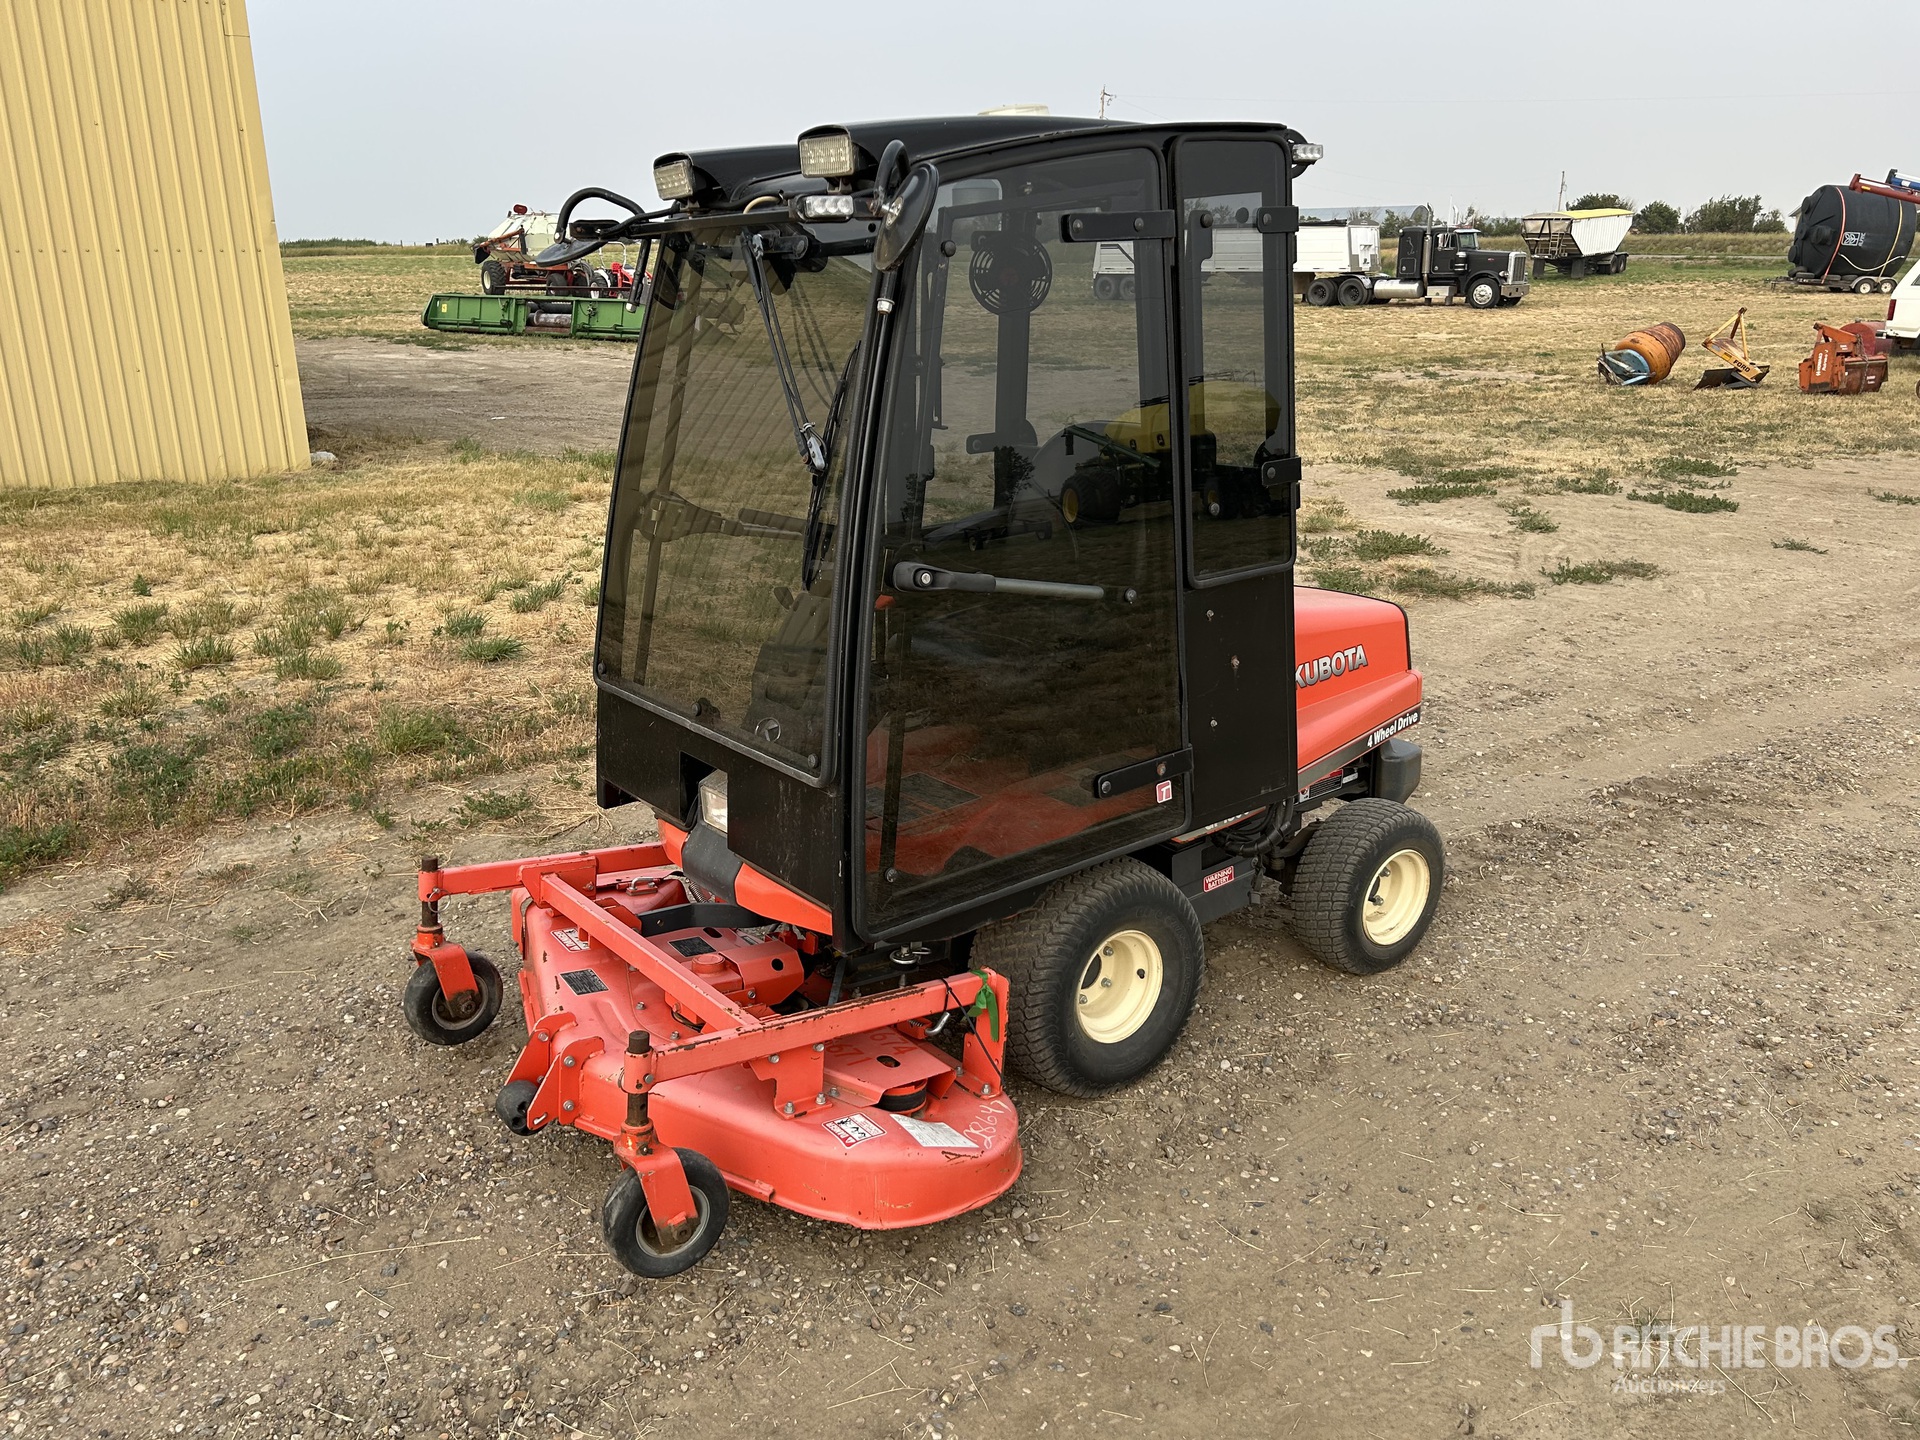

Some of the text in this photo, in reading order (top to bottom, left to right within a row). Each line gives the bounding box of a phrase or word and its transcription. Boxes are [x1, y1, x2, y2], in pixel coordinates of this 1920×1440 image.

[1733, 359, 1751, 373] FORD
[1295, 644, 1368, 688] KUBOTA
[1367, 711, 1418, 748] 4 Wheel Drive
[1205, 867, 1232, 883] WARNING
